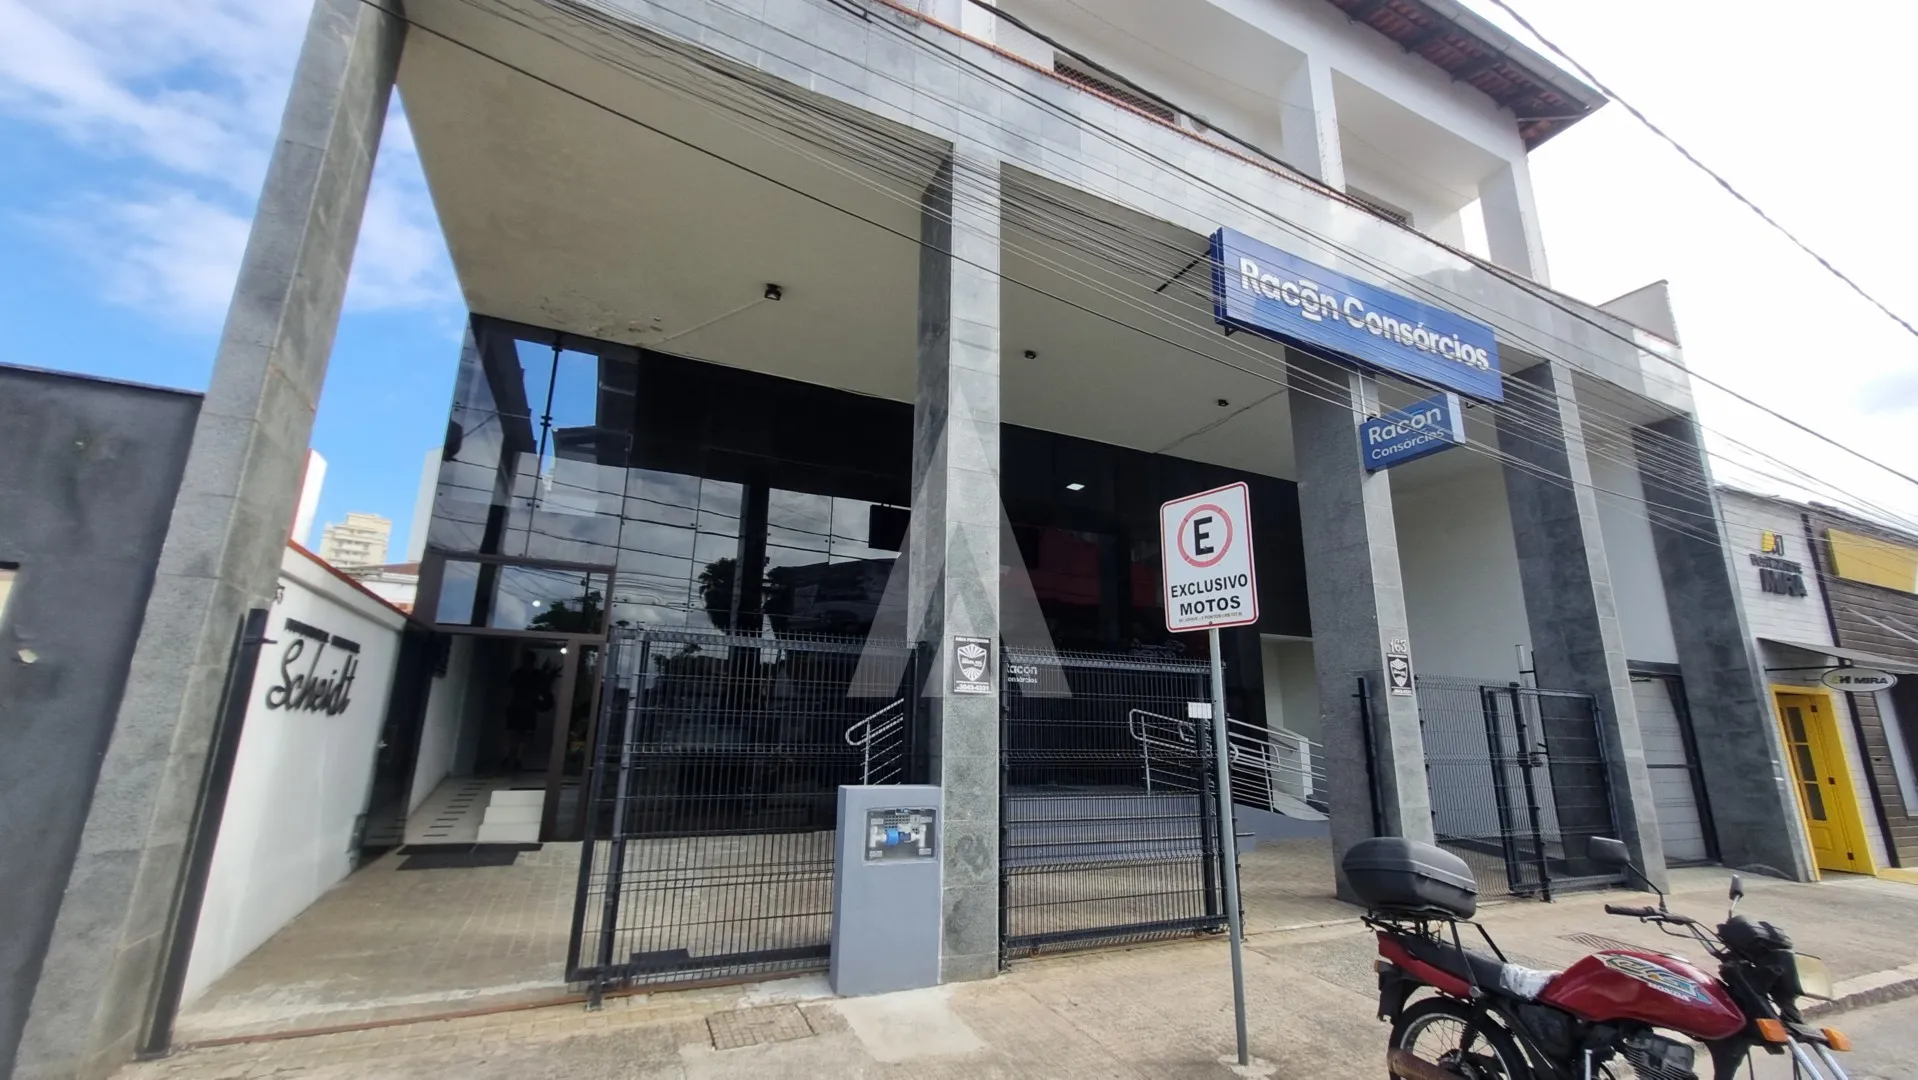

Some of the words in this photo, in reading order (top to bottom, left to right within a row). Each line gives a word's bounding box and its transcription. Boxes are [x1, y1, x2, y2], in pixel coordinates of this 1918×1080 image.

[1343, 293, 1490, 371] Consórcios
[1371, 429, 1445, 460] Consórcios
[1193, 516, 1214, 556] E
[1170, 573, 1248, 598] EXCLUSIVO
[1180, 595, 1241, 616] MOTOS
[1853, 677, 1889, 685] MIRA
